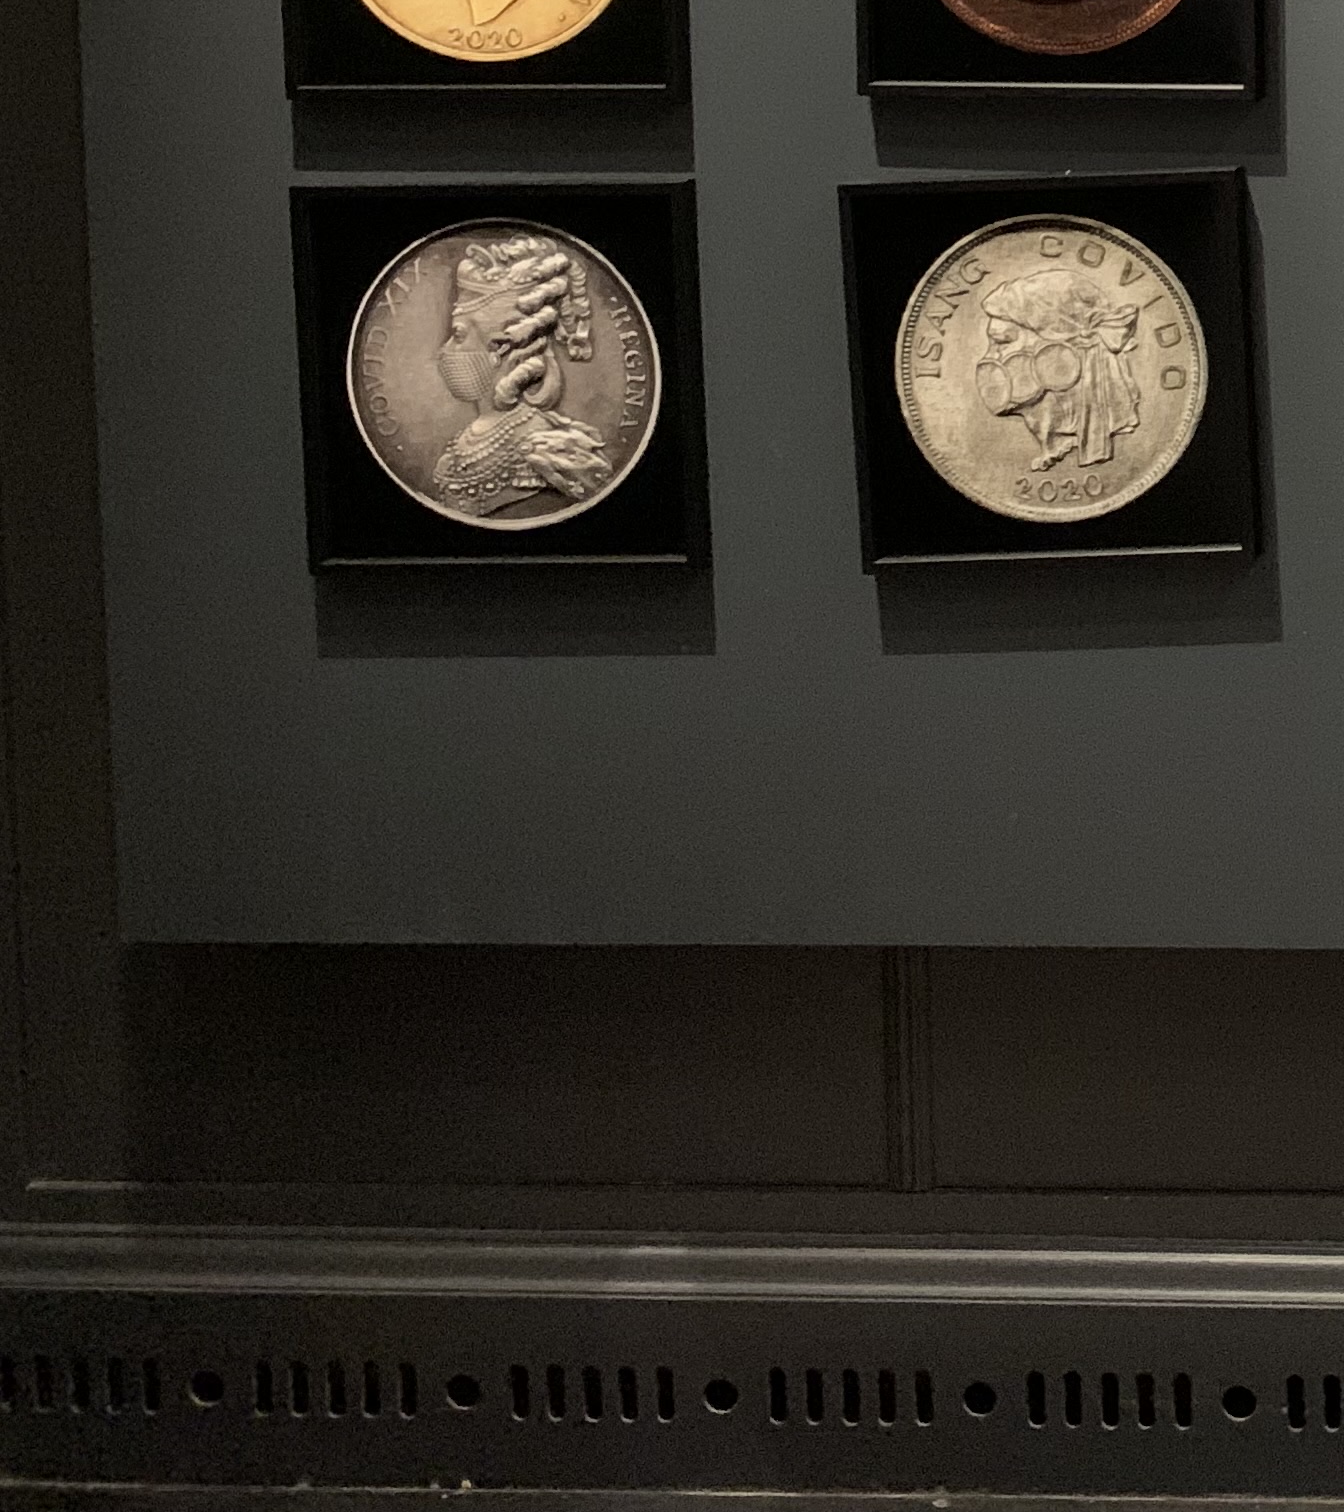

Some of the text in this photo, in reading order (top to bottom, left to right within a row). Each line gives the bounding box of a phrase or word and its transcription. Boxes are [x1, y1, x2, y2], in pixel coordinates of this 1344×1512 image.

[447, 27, 524, 50] 2020
[609, 303, 647, 429] REGINA
[915, 257, 992, 380] ISANG
[363, 325, 398, 437] COVID
[1015, 473, 1105, 504] 2020
